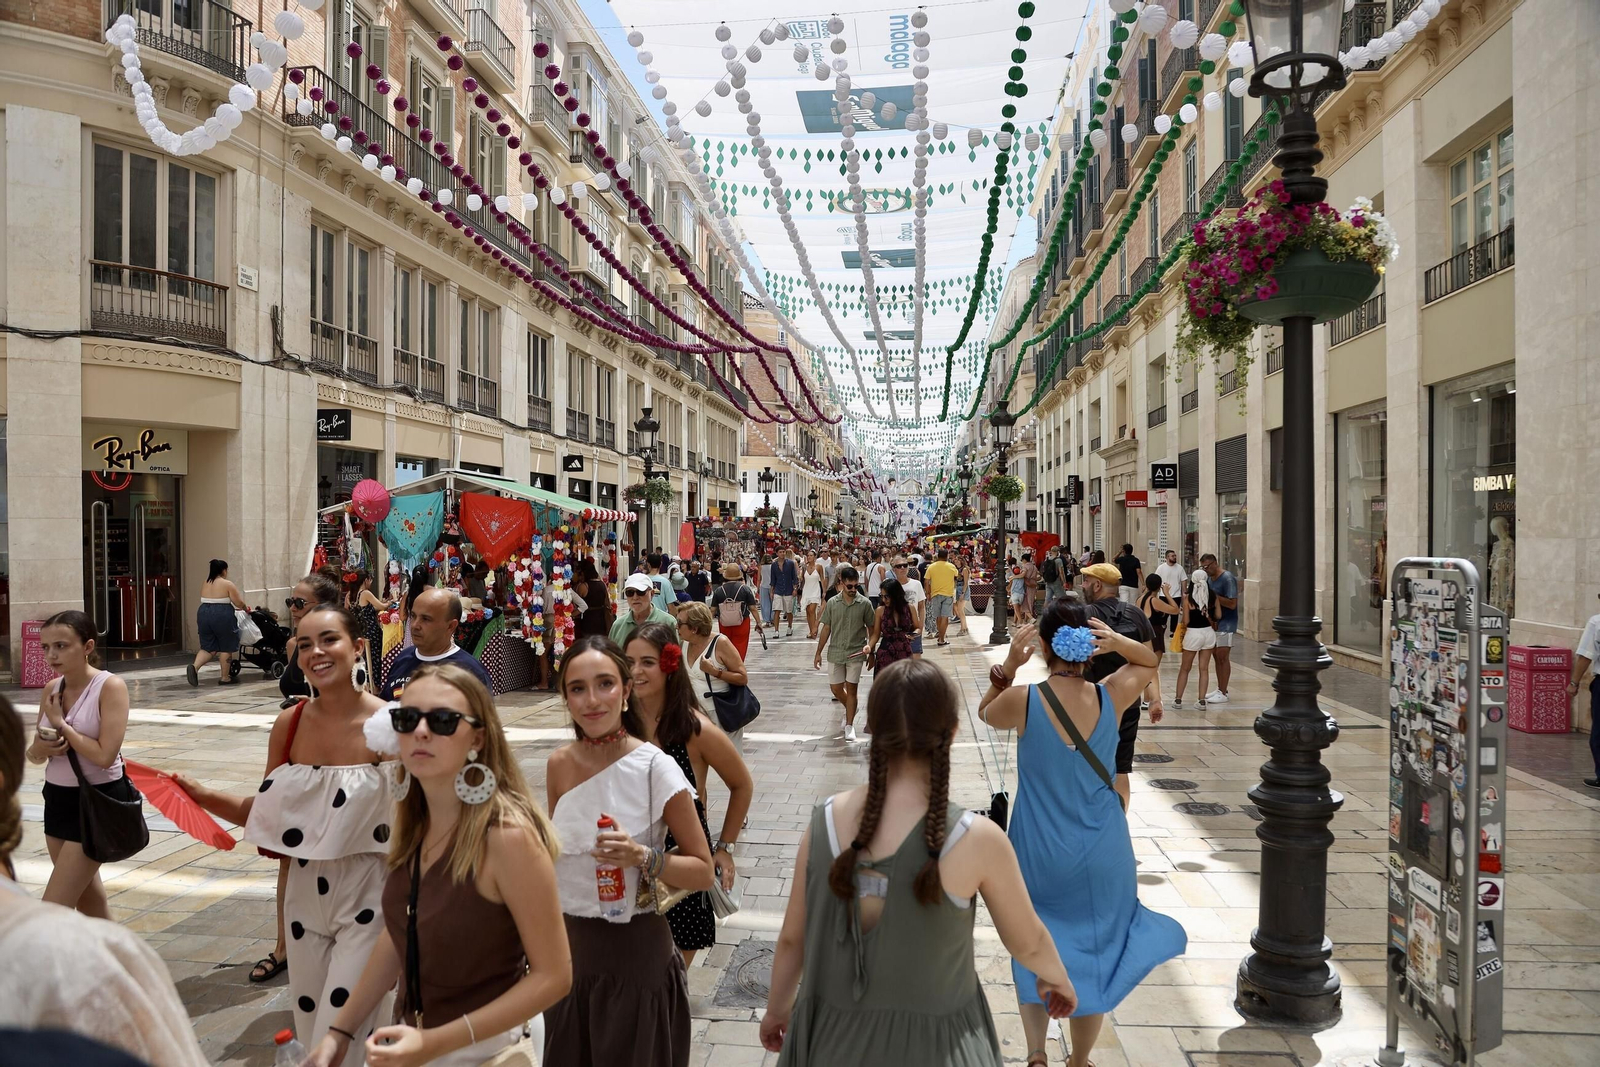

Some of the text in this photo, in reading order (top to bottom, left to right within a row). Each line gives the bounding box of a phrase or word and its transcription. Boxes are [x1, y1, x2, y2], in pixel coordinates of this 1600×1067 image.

[317, 414, 346, 433] Ray-Ban
[92, 429, 172, 470] Ray-Ban
[341, 465, 361, 473] SMART
[1155, 468, 1174, 477] AD
[1473, 473, 1514, 492] BIMBA Y
[1537, 656, 1563, 664] CARTOJAL
